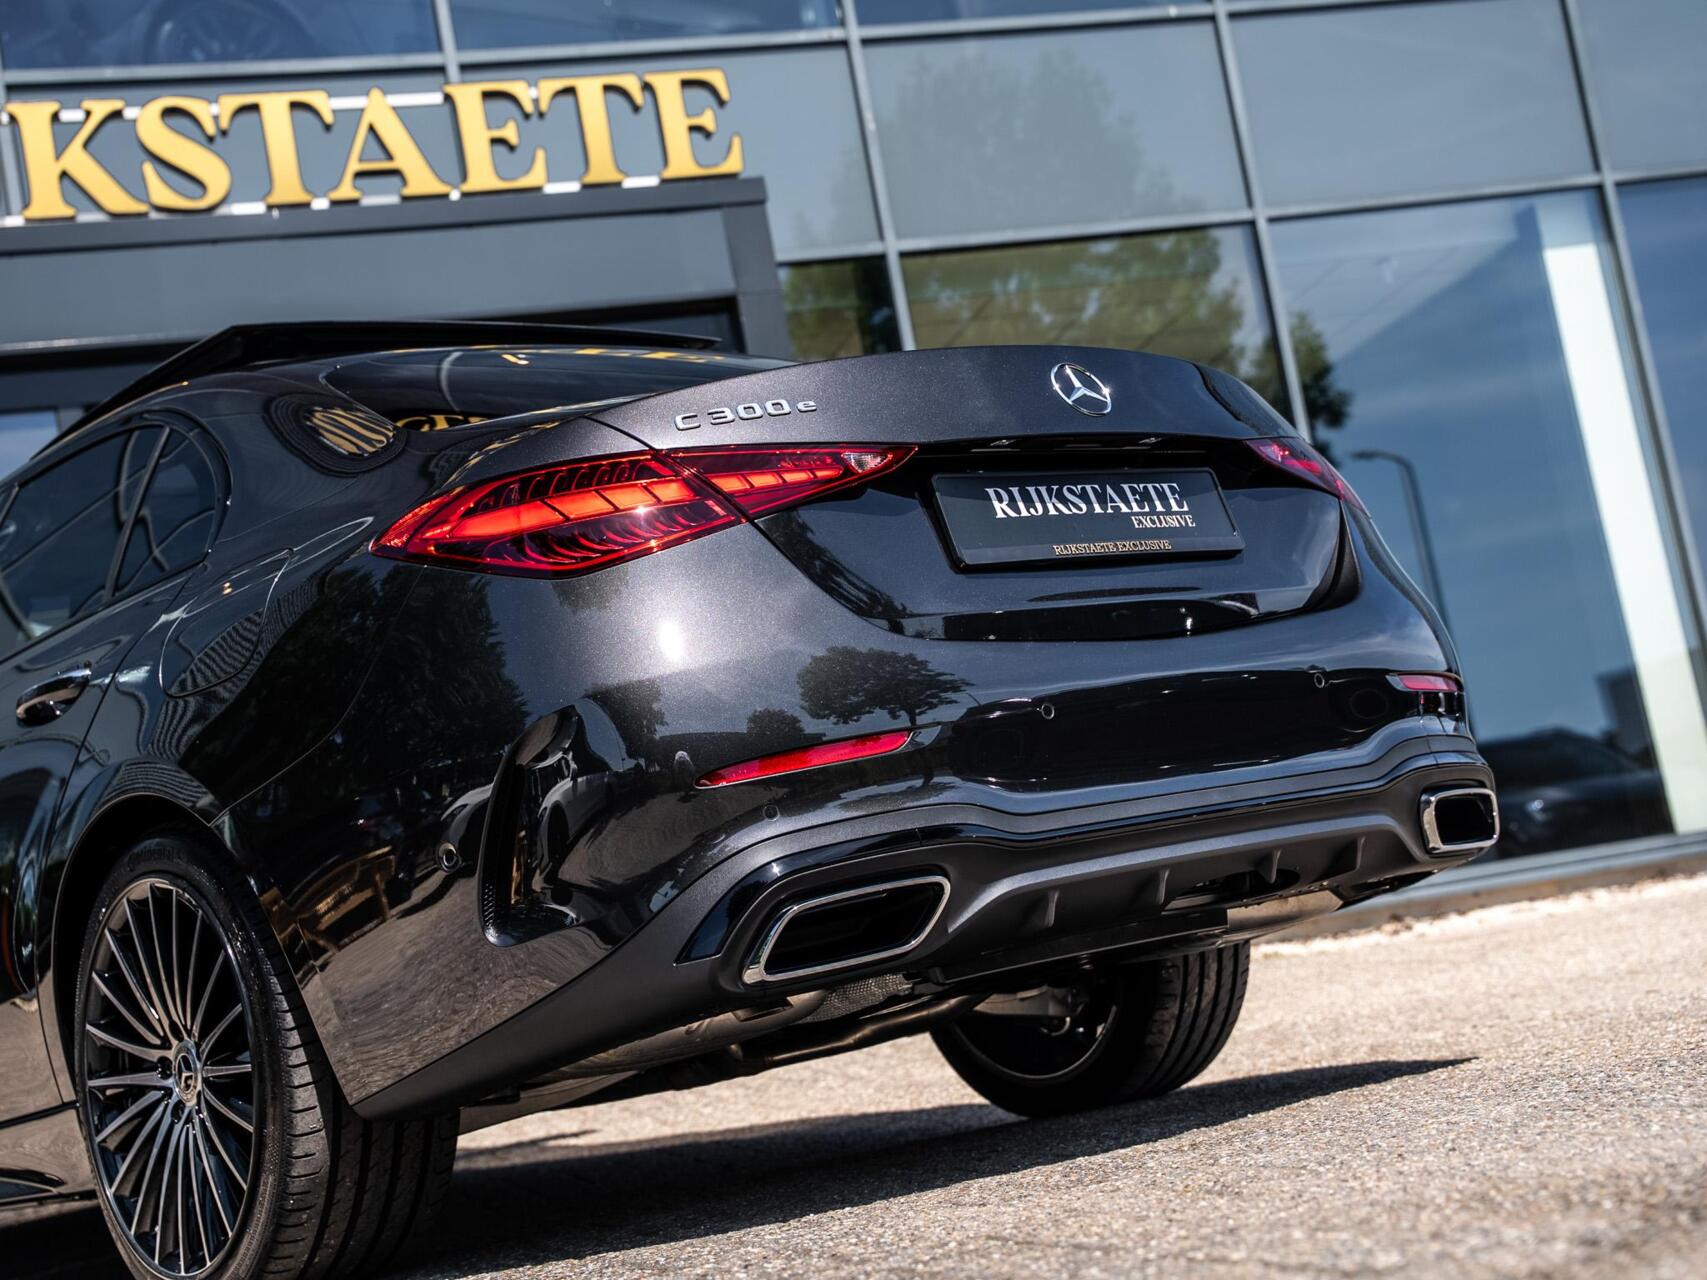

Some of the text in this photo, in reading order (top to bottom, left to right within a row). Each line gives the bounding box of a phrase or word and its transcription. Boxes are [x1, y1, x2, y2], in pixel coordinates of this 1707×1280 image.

[4, 68, 745, 220] KSTAETE
[674, 412, 701, 431] C
[984, 482, 1190, 519] RIJKSTAETE
[1131, 514, 1196, 529] EXCLUSIVE
[1052, 539, 1172, 556] RIJKSTAETE EXCLUSIVE
